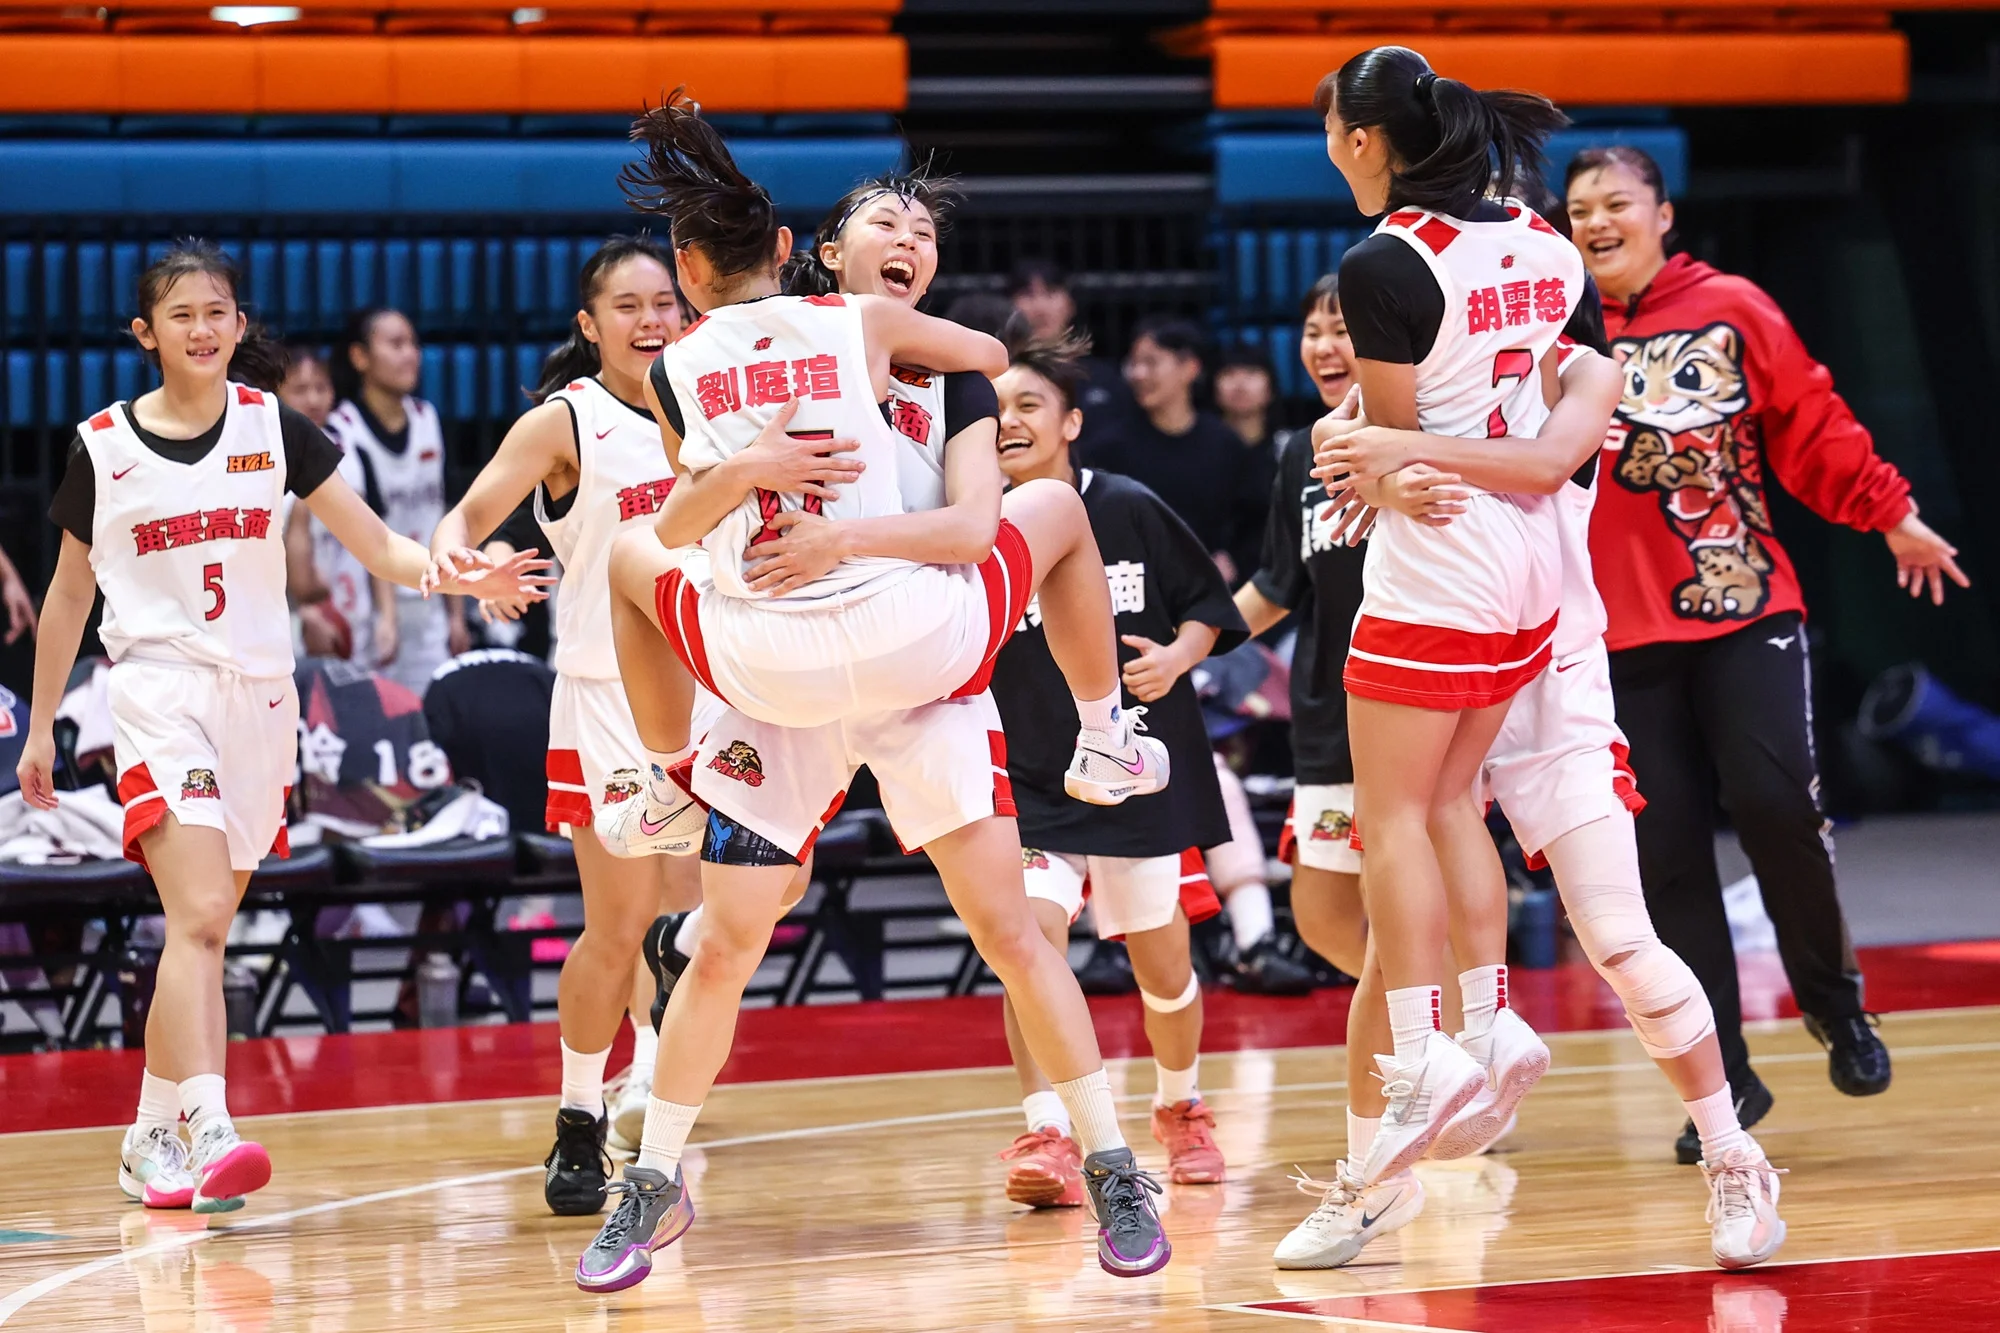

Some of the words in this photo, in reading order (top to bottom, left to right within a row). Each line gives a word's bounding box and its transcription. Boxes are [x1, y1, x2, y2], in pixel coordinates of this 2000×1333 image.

[696, 353, 842, 421] 劉庭瑄
[131, 506, 272, 556] 苗栗高商
[203, 562, 226, 622] 5
[373, 738, 453, 789] 18
